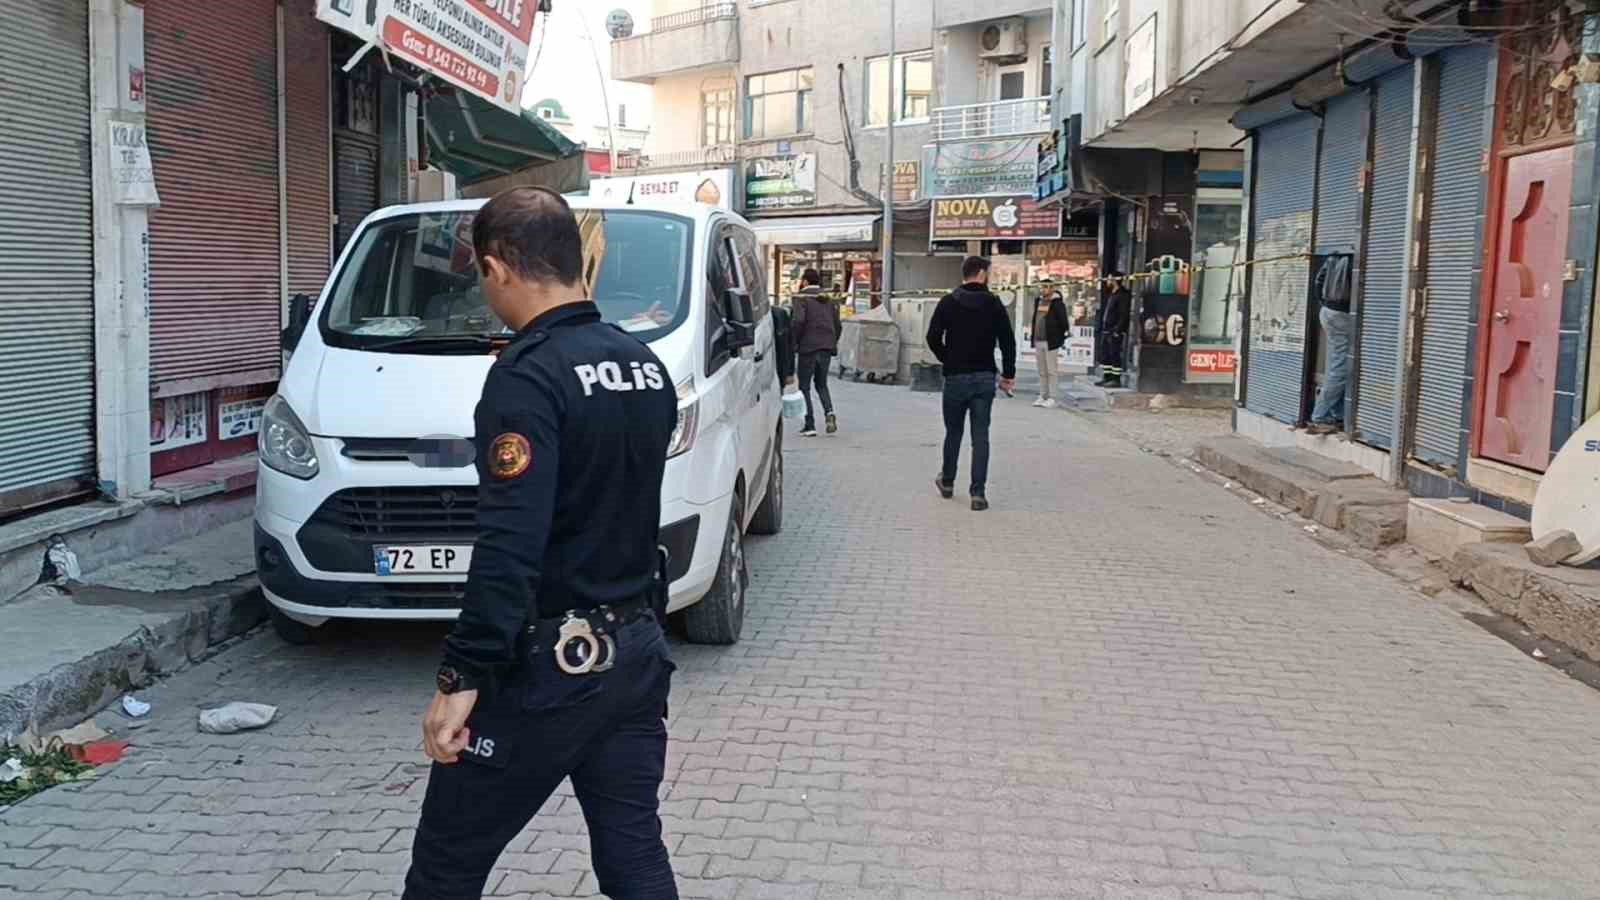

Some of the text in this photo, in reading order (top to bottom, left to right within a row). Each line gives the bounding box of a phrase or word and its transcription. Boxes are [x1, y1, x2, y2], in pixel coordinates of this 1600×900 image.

[640, 180, 680, 195] BEYAZ ET
[936, 198, 991, 217] NOVA
[1191, 353, 1217, 371] GENÇ
[574, 360, 665, 397] POLİS
[388, 548, 456, 570] 72 EP
